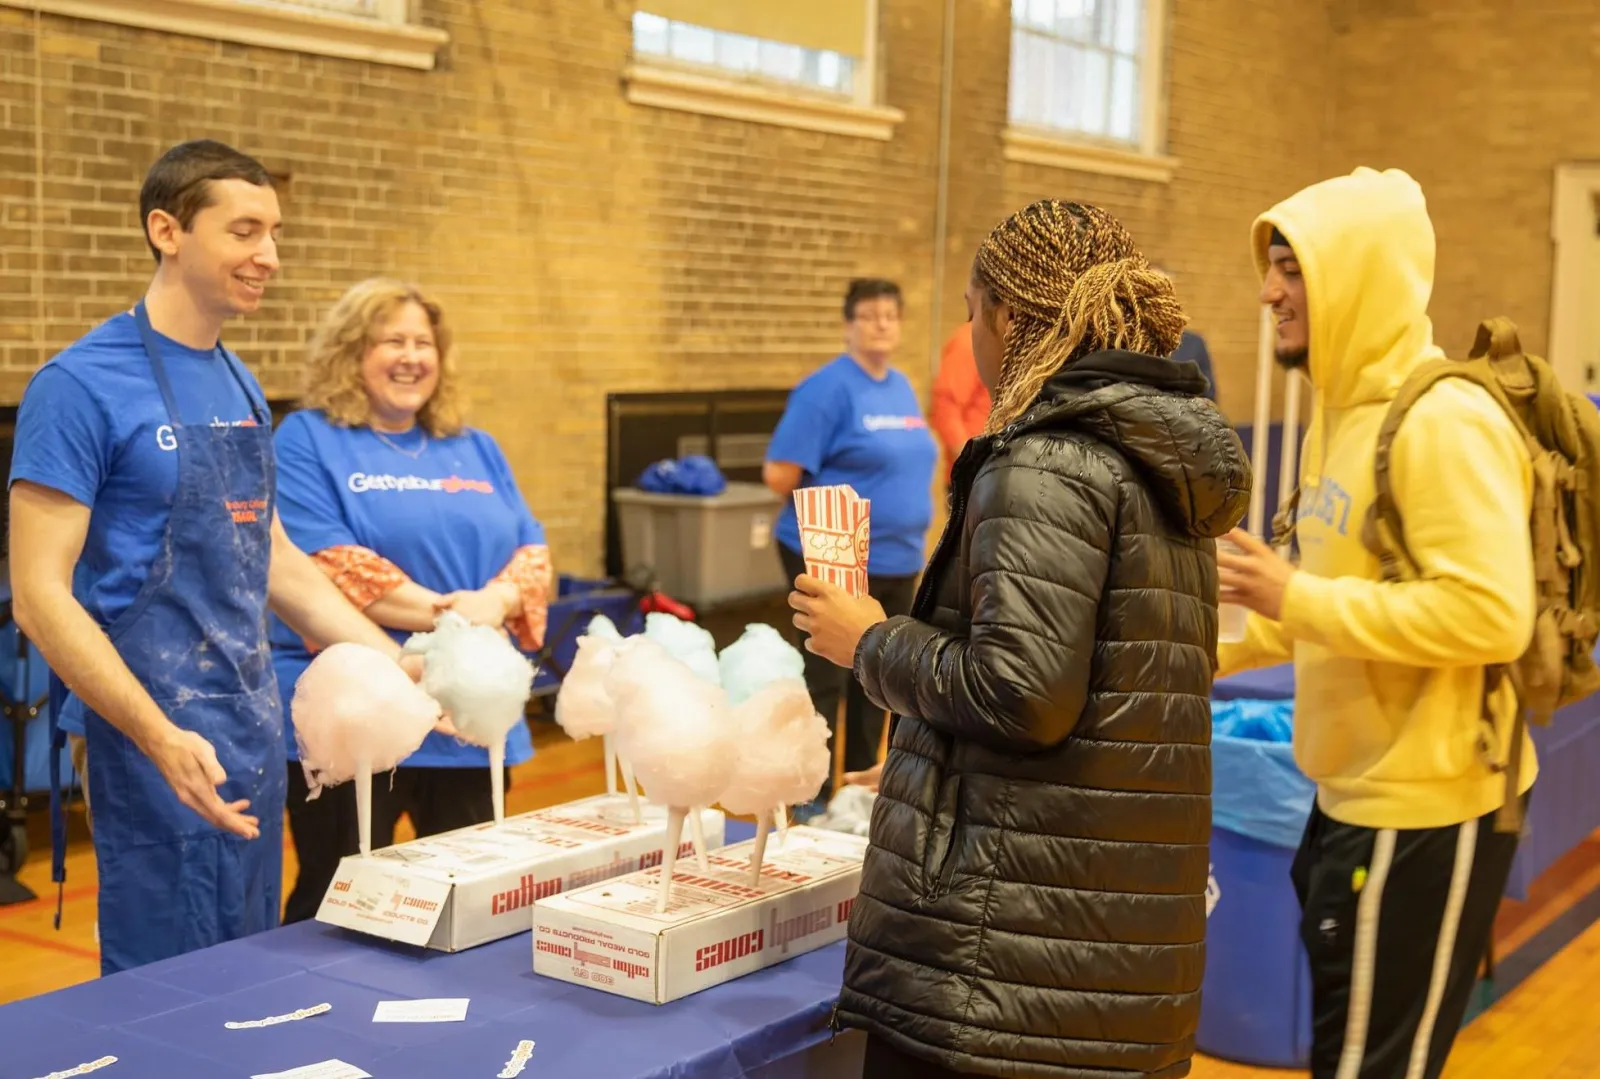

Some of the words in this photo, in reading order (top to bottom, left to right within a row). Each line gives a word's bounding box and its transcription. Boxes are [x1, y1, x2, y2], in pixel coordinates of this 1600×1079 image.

[491, 873, 562, 916] cotton
[552, 929, 595, 945] PRODUCTS
[769, 906, 833, 954] candy
[536, 939, 572, 958] cones
[599, 940, 626, 952] MEDAL
[627, 947, 650, 958] GOLD
[695, 929, 764, 972] cones
[613, 959, 650, 979] cotton
